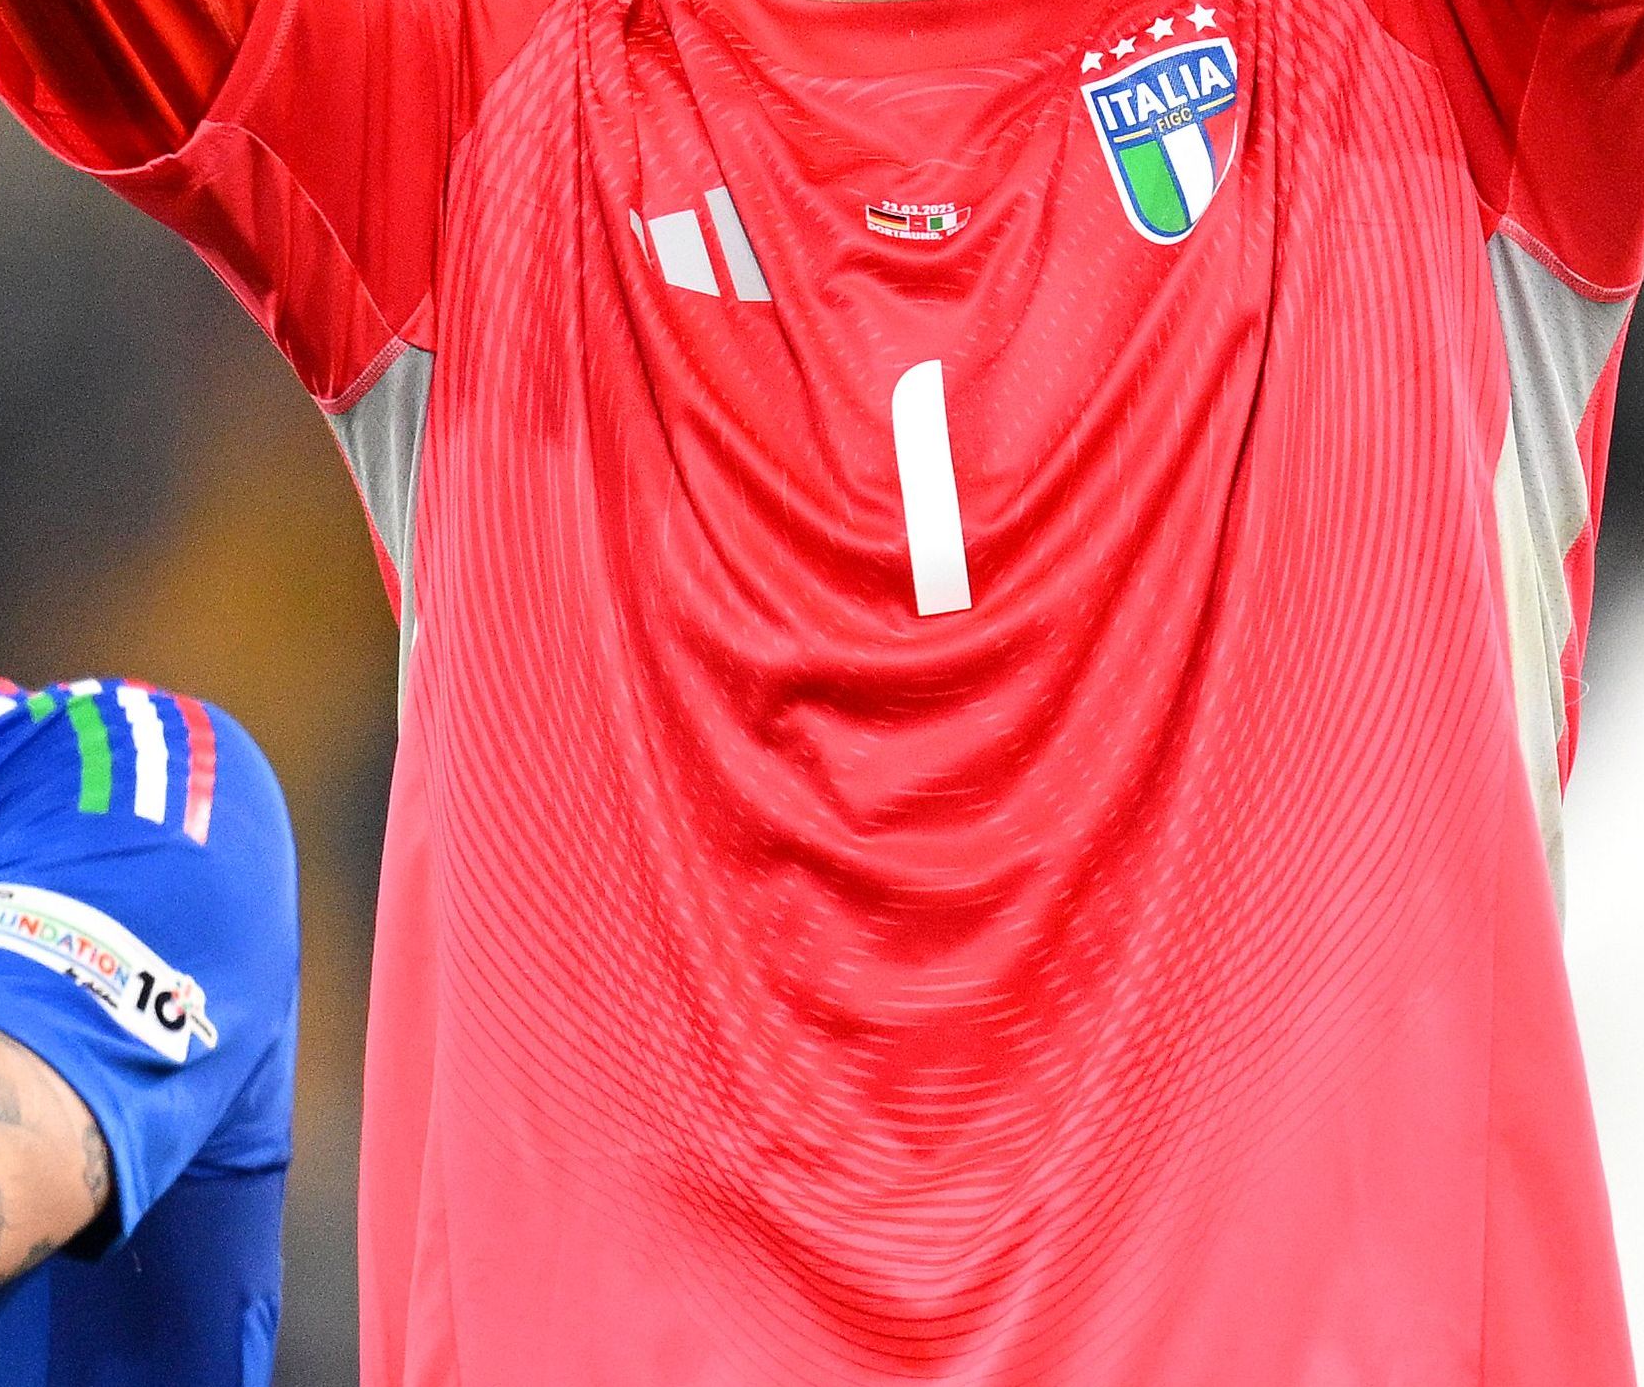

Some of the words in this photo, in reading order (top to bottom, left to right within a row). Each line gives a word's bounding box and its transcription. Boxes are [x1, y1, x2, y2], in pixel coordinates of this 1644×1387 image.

[1096, 55, 1231, 131] ITALIA
[881, 200, 956, 216] 23.03.2025
[891, 358, 973, 617] 1
